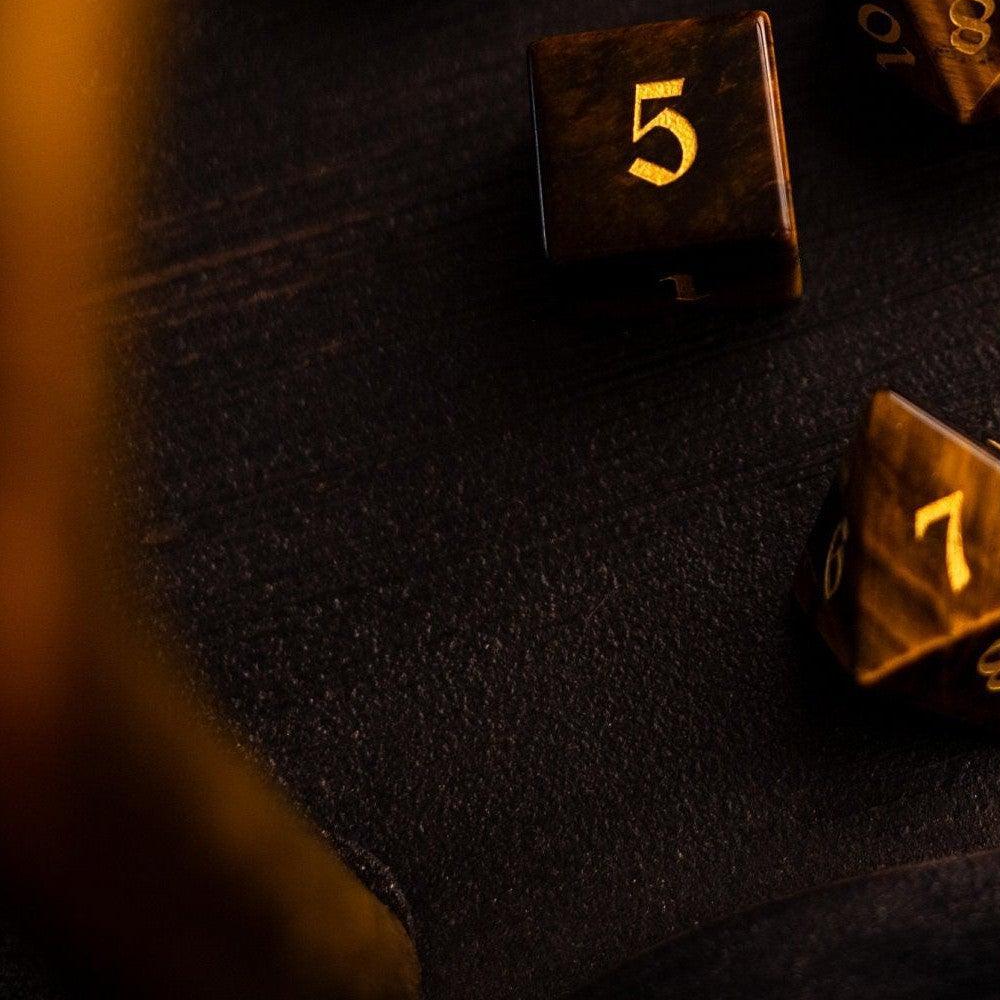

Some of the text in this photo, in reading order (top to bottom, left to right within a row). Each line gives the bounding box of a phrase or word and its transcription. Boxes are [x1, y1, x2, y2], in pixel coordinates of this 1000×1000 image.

[857, 2, 917, 72] 10
[627, 76, 699, 187] 5
[914, 490, 972, 595] 7
